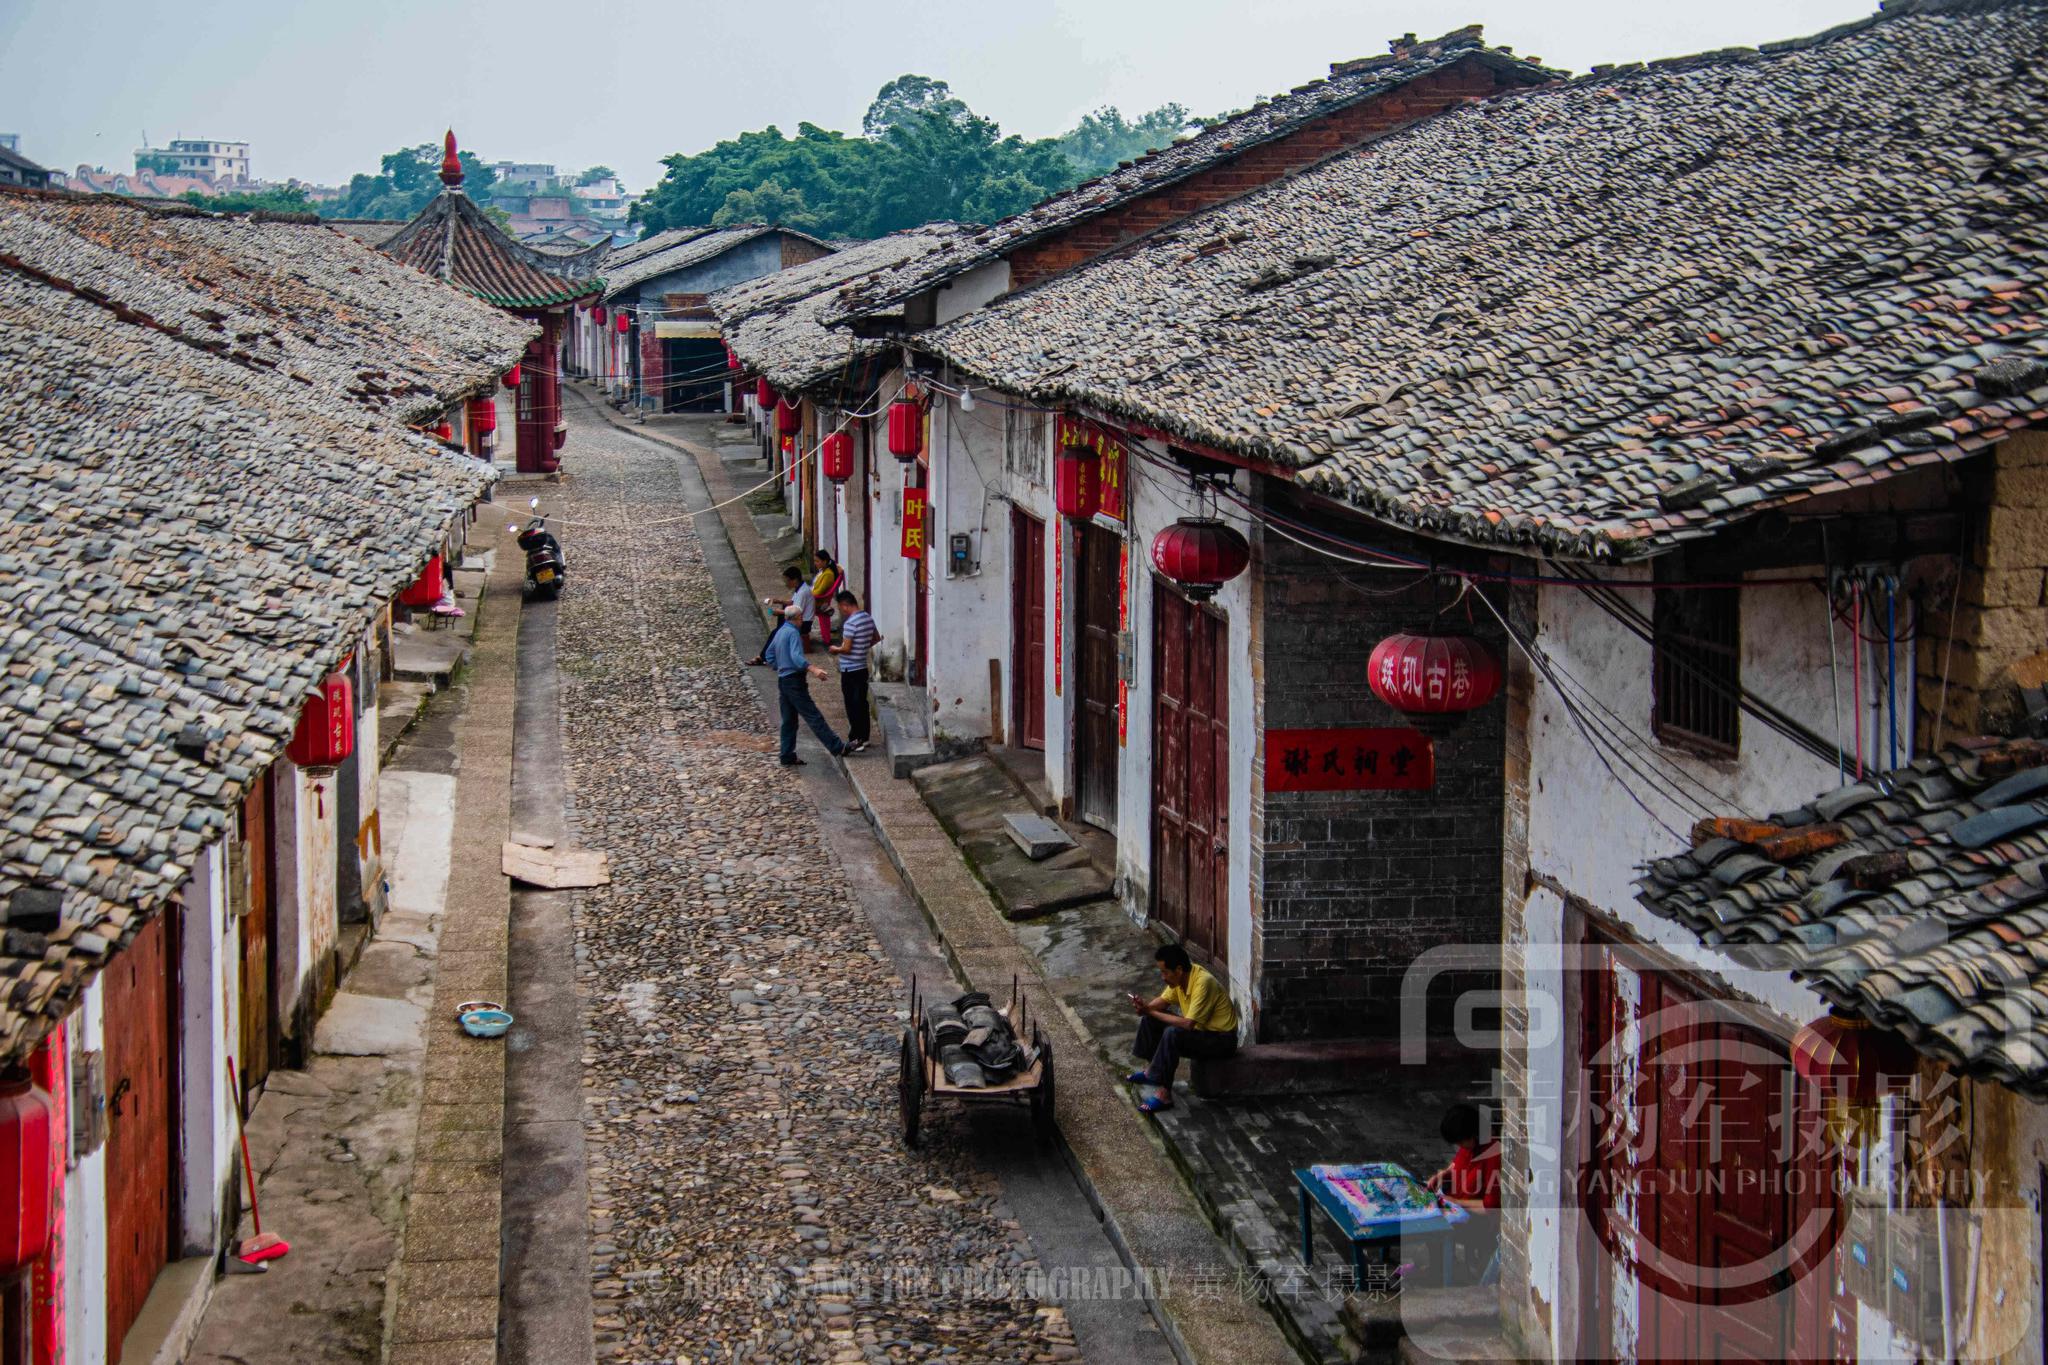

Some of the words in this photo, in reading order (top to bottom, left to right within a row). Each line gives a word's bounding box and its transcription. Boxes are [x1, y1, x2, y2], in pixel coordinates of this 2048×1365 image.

[906, 499, 924, 548] 叶氏
[1381, 656, 1470, 700] 珠玑古巷
[1279, 746, 1416, 778] 谢氏祠堂
